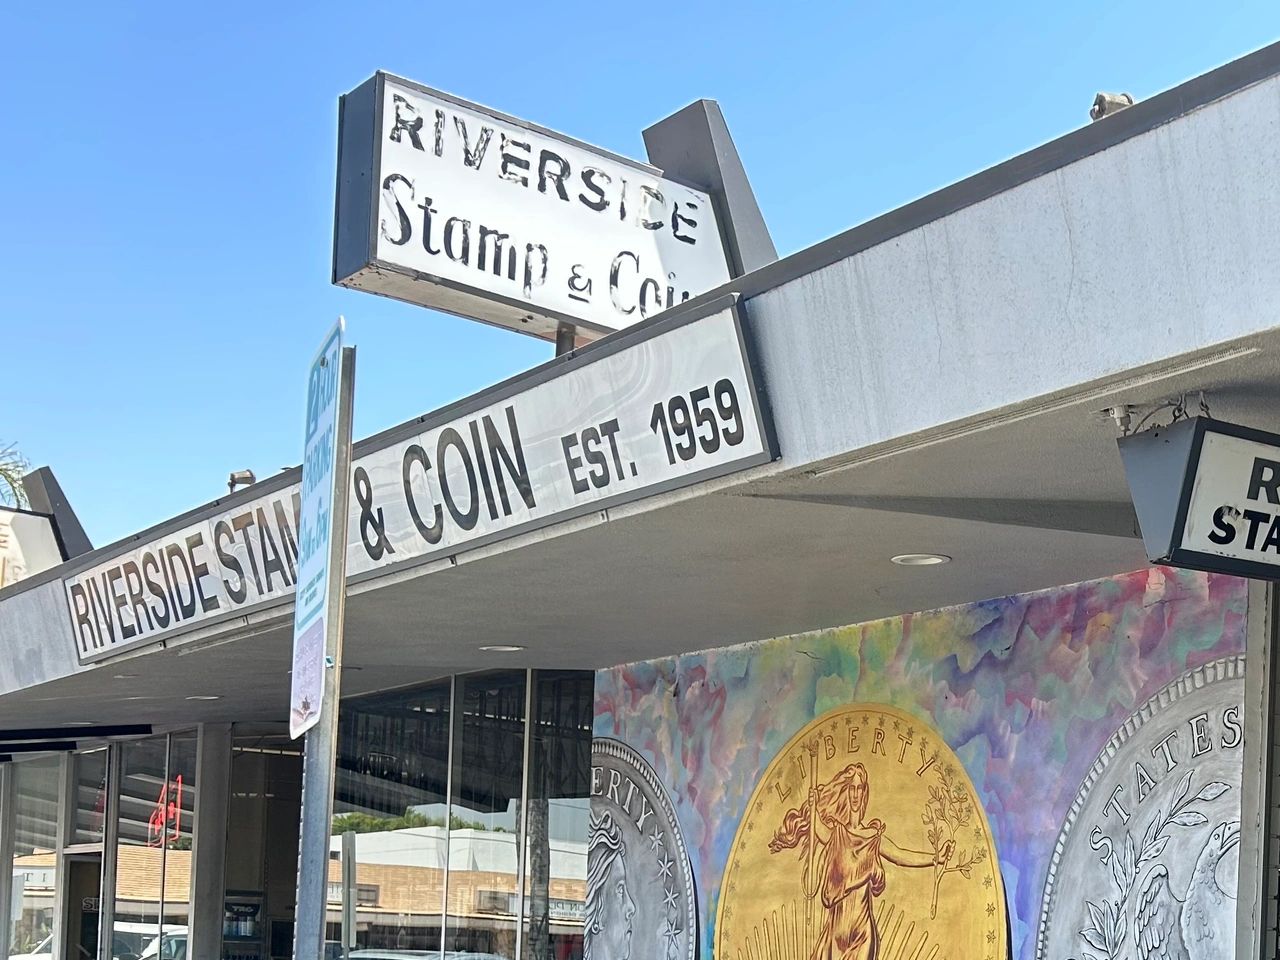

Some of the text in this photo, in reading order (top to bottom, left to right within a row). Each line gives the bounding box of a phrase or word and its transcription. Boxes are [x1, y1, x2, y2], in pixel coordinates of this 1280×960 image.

[381, 173, 690, 319] Stamp & Coi
[70, 531, 219, 652] RIVERSIDE
[214, 492, 302, 605] STAM
[354, 466, 395, 561] &
[403, 405, 536, 545] COIN
[561, 418, 638, 495] EST.
[650, 378, 744, 465] 1959
[775, 727, 935, 803] LIBERTY
[1088, 706, 1245, 864] STATES
